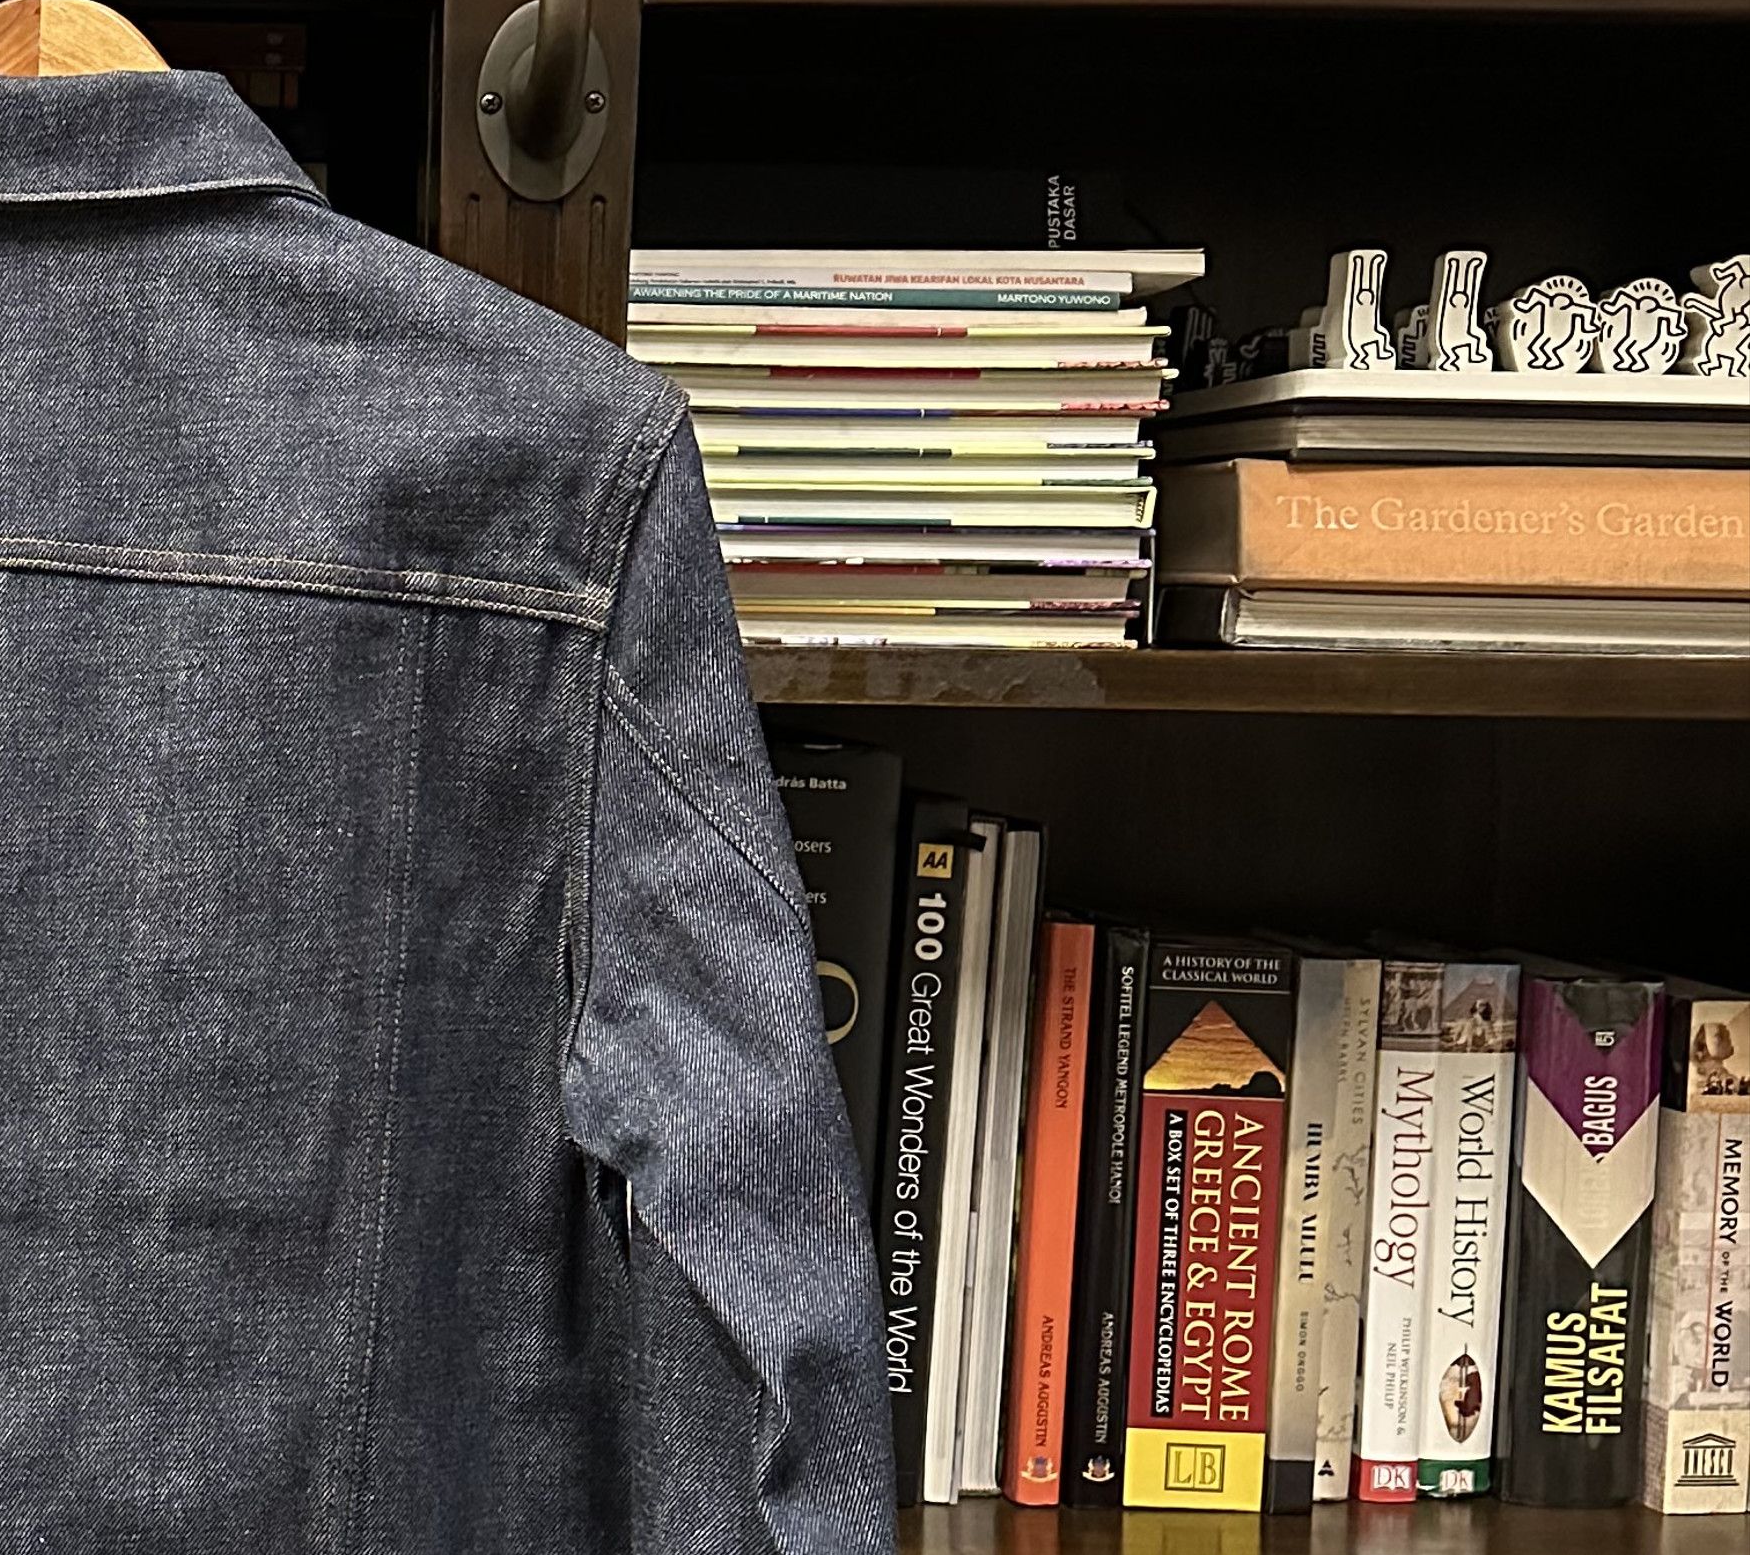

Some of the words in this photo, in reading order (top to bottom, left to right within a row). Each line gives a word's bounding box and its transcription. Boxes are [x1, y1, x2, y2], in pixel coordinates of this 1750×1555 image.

[998, 294, 1058, 306] MARTONO
[1063, 294, 1110, 306] YUWONO
[1280, 496, 1358, 530] The
[1373, 497, 1584, 534] Gardener's
[1596, 501, 1744, 540] Garden
[917, 892, 947, 962] 100
[908, 970, 944, 1055] Great
[894, 1063, 934, 1202] Wonders
[1189, 1109, 1227, 1255] GREECE
[1374, 1067, 1434, 1288] Mythology
[1456, 1074, 1496, 1183] World
[894, 1209, 919, 1236] of
[1229, 1113, 1264, 1300] ANCIENT
[1439, 1196, 1488, 1328] History
[891, 1238, 924, 1297] the
[1188, 1264, 1212, 1293] &
[886, 1306, 918, 1393] World
[1180, 1301, 1217, 1420] EGYPT
[1221, 1310, 1254, 1423] ROME
[1542, 1311, 1587, 1434] KAMUS
[1585, 1281, 1628, 1434] FILSAFAT
